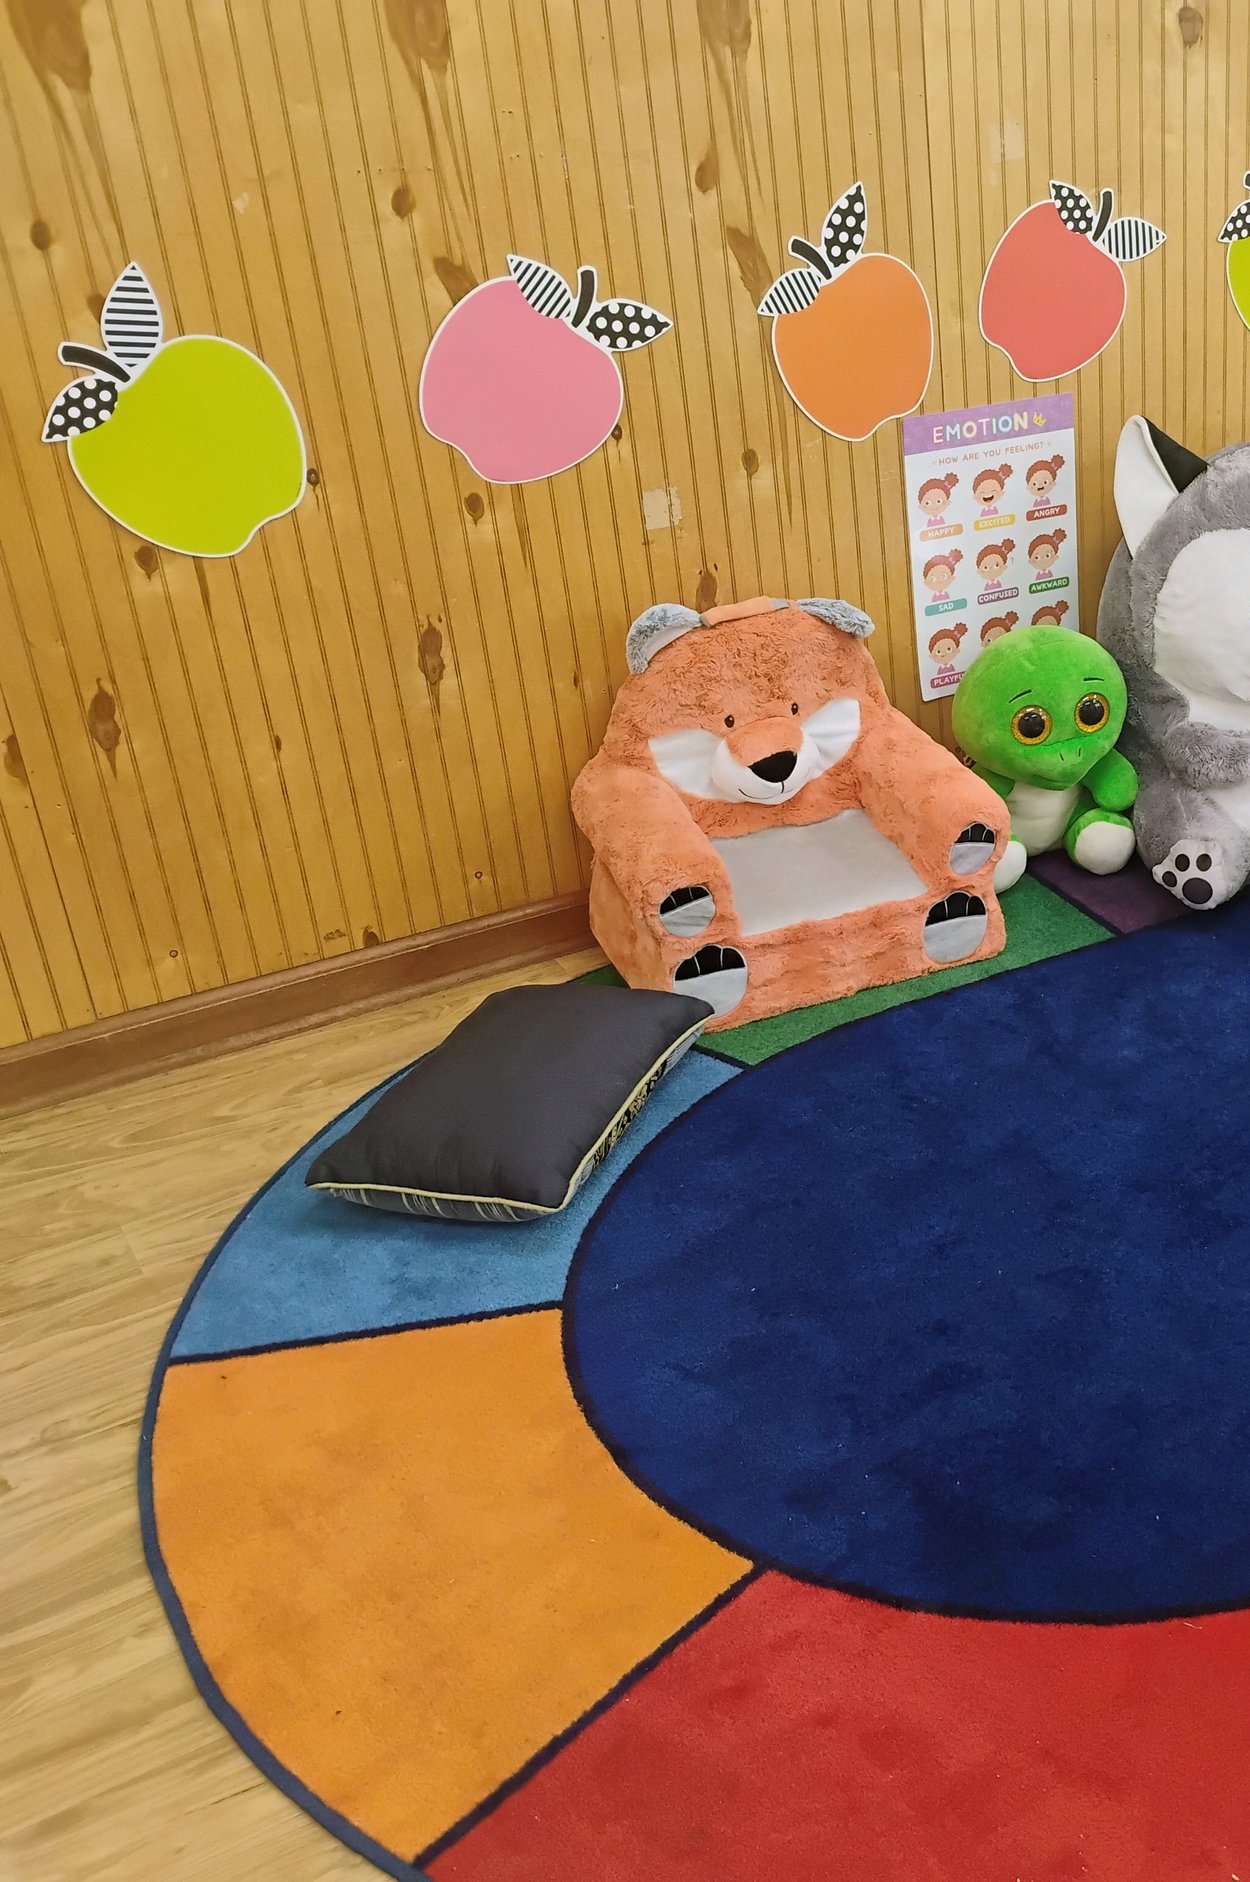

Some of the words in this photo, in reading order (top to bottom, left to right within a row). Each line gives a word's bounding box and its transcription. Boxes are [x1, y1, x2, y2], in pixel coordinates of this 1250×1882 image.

[933, 411, 1029, 444] EMOTION
[939, 455, 958, 466] HOW
[962, 453, 979, 461] ARE
[983, 449, 1001, 458] YOU
[1005, 441, 1044, 454] FEELING?
[1033, 507, 1060, 519] ANGRY
[979, 517, 1011, 528] EXCITED
[928, 527, 954, 537] HAPPY
[1031, 578, 1067, 592] AWKWARD
[978, 588, 1018, 603] CONFUSED
[938, 602, 953, 611] SAD
[934, 673, 964, 686] PLAYFU
